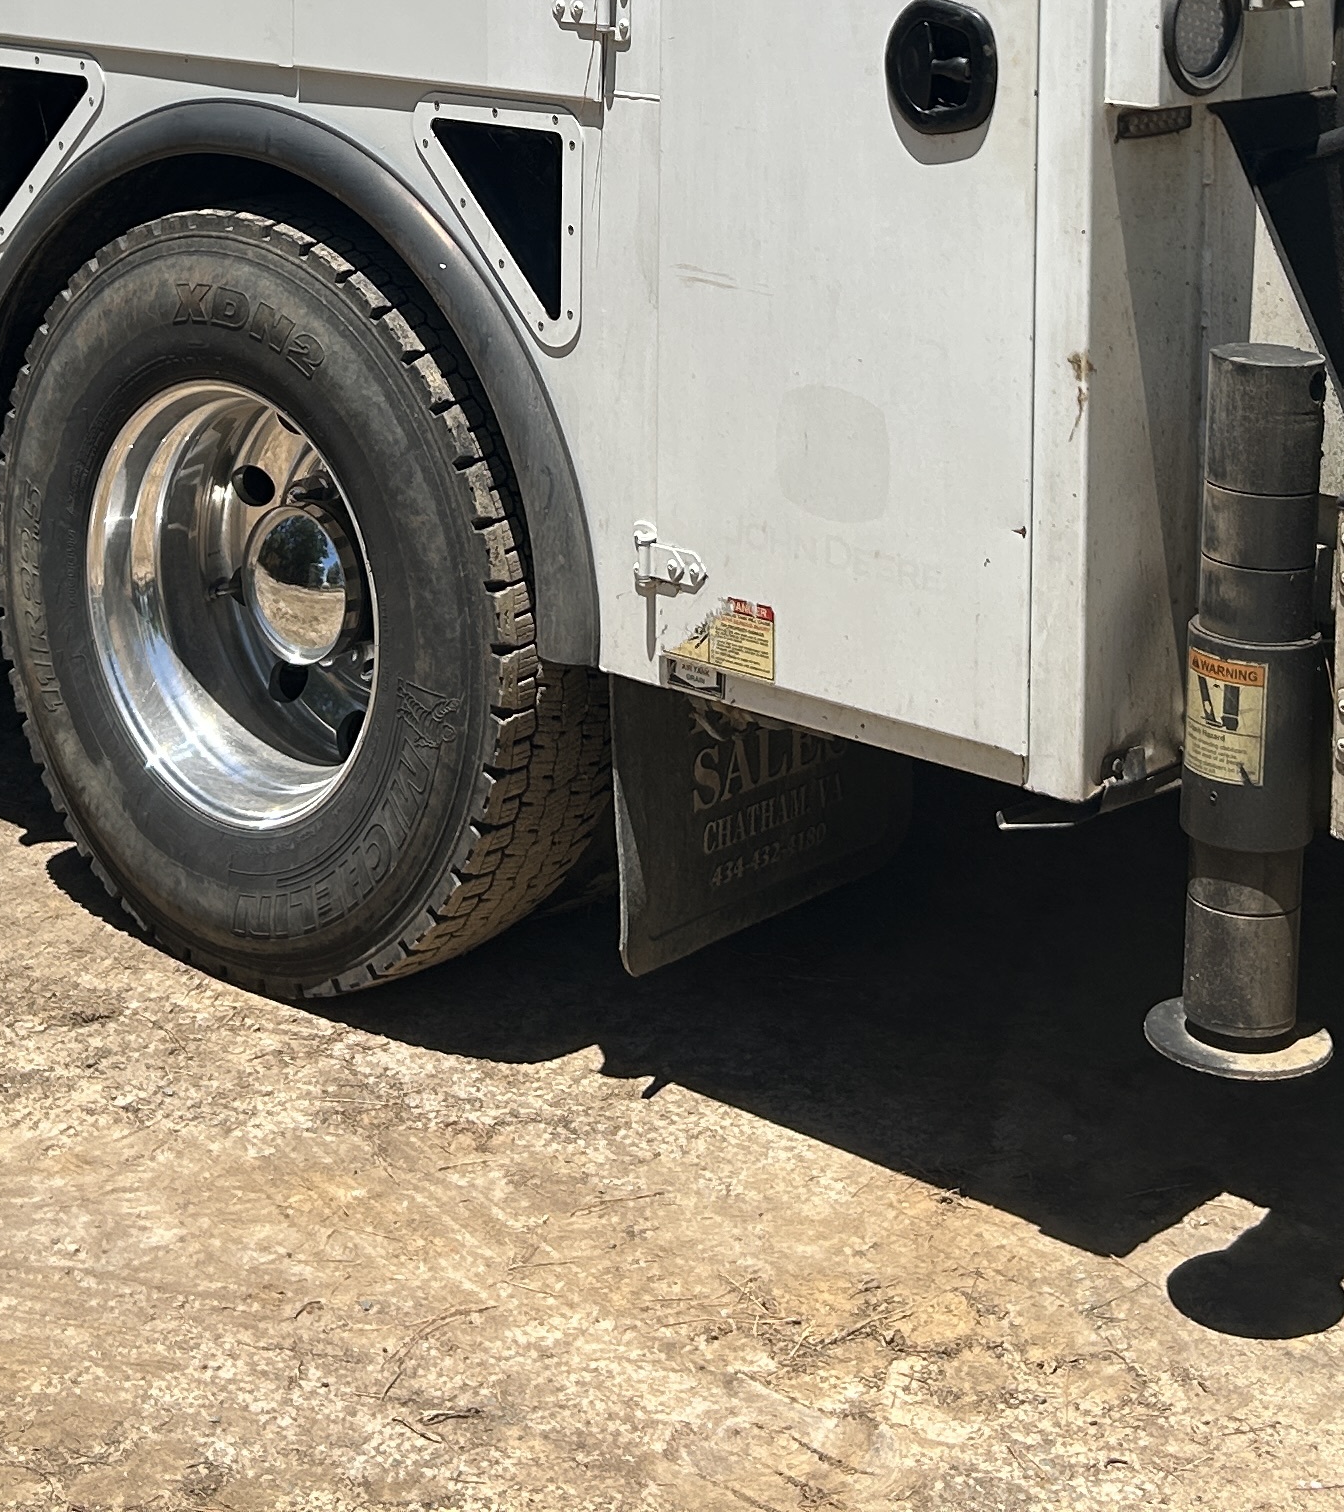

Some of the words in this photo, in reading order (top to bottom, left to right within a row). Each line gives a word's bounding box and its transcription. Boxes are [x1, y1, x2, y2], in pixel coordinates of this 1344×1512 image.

[172, 282, 326, 380] XDN2
[21, 478, 65, 713] 11R22.5
[681, 663, 693, 672] AIR
[693, 665, 711, 678] TANK
[685, 673, 706, 685] DRAIN
[1200, 659, 1259, 683] WARNING
[231, 735, 431, 940] MICHELIN
